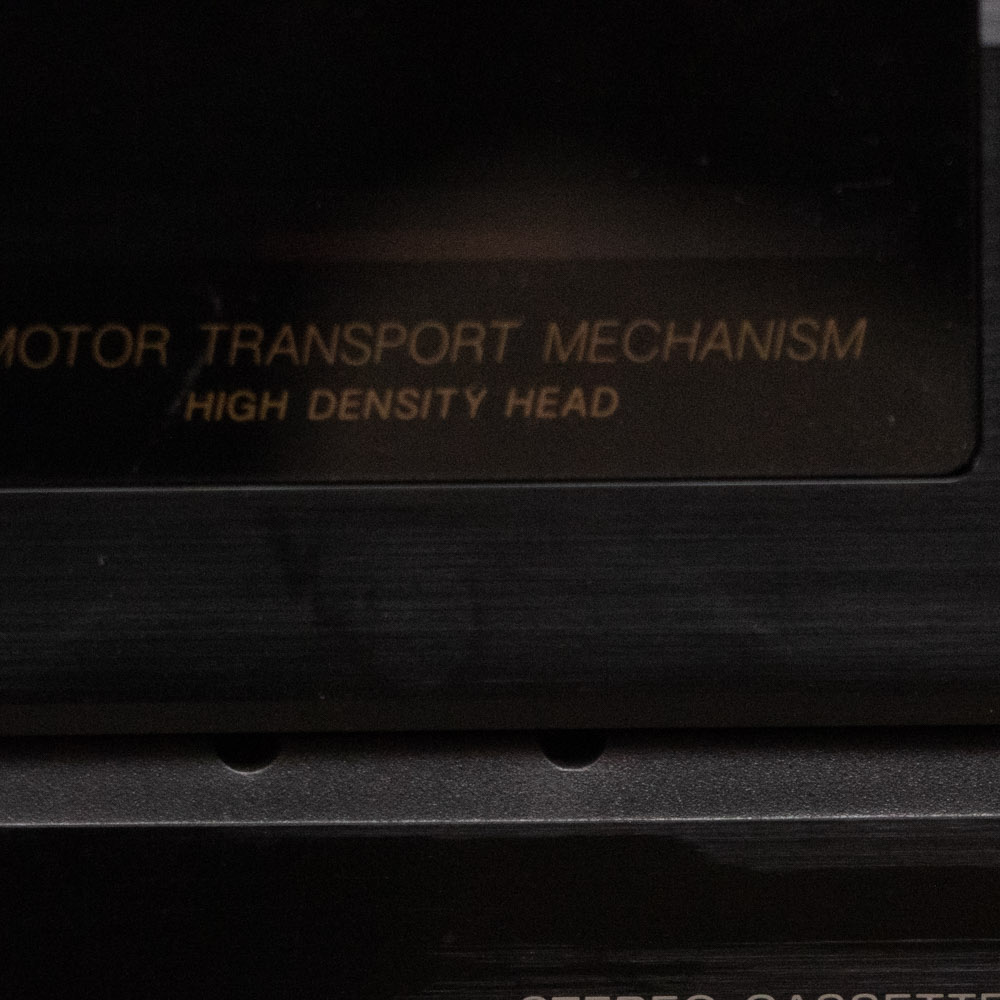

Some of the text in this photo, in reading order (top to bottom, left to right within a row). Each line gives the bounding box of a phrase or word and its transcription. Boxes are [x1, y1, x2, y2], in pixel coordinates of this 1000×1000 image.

[200, 320, 523, 367] TRANSPORT
[543, 317, 869, 363] MECHANISM
[183, 387, 621, 422] HIGH DENSITY HEAD
